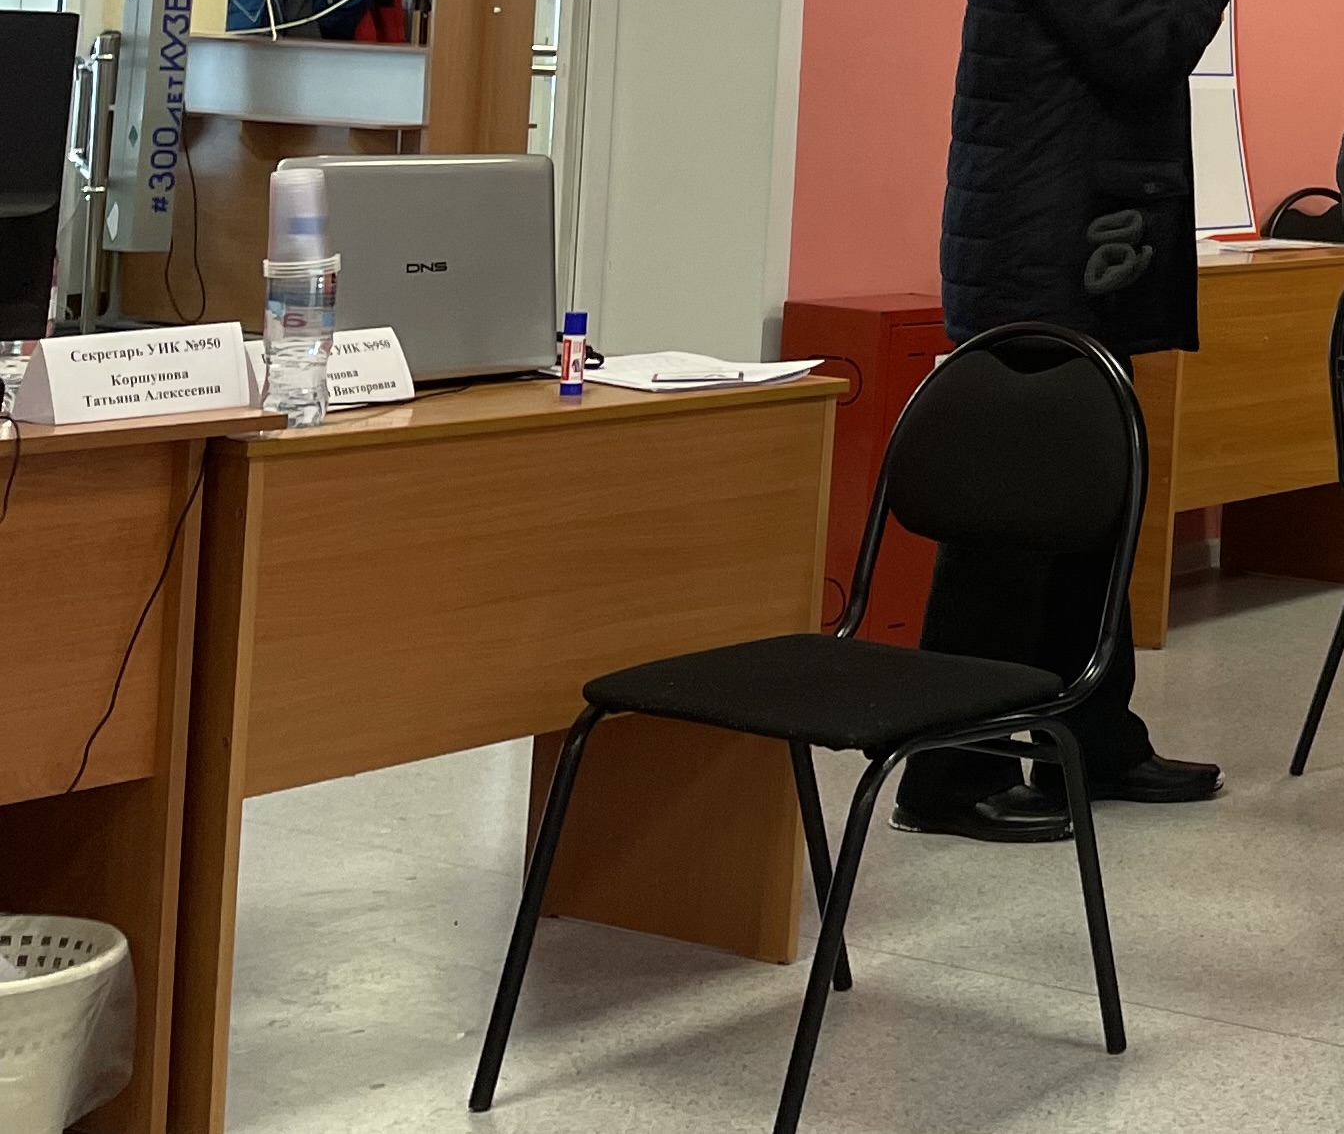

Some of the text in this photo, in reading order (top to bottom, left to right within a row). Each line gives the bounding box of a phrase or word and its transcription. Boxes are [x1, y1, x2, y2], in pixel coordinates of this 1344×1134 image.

[406, 261, 448, 274] DNS
[70, 337, 222, 364] Секретарь УИК №950
[334, 343, 361, 356] УИК
[111, 370, 189, 388] Коршунова
[82, 384, 222, 408] Татьяна Алексеевна
[333, 380, 397, 397] Викторовна
